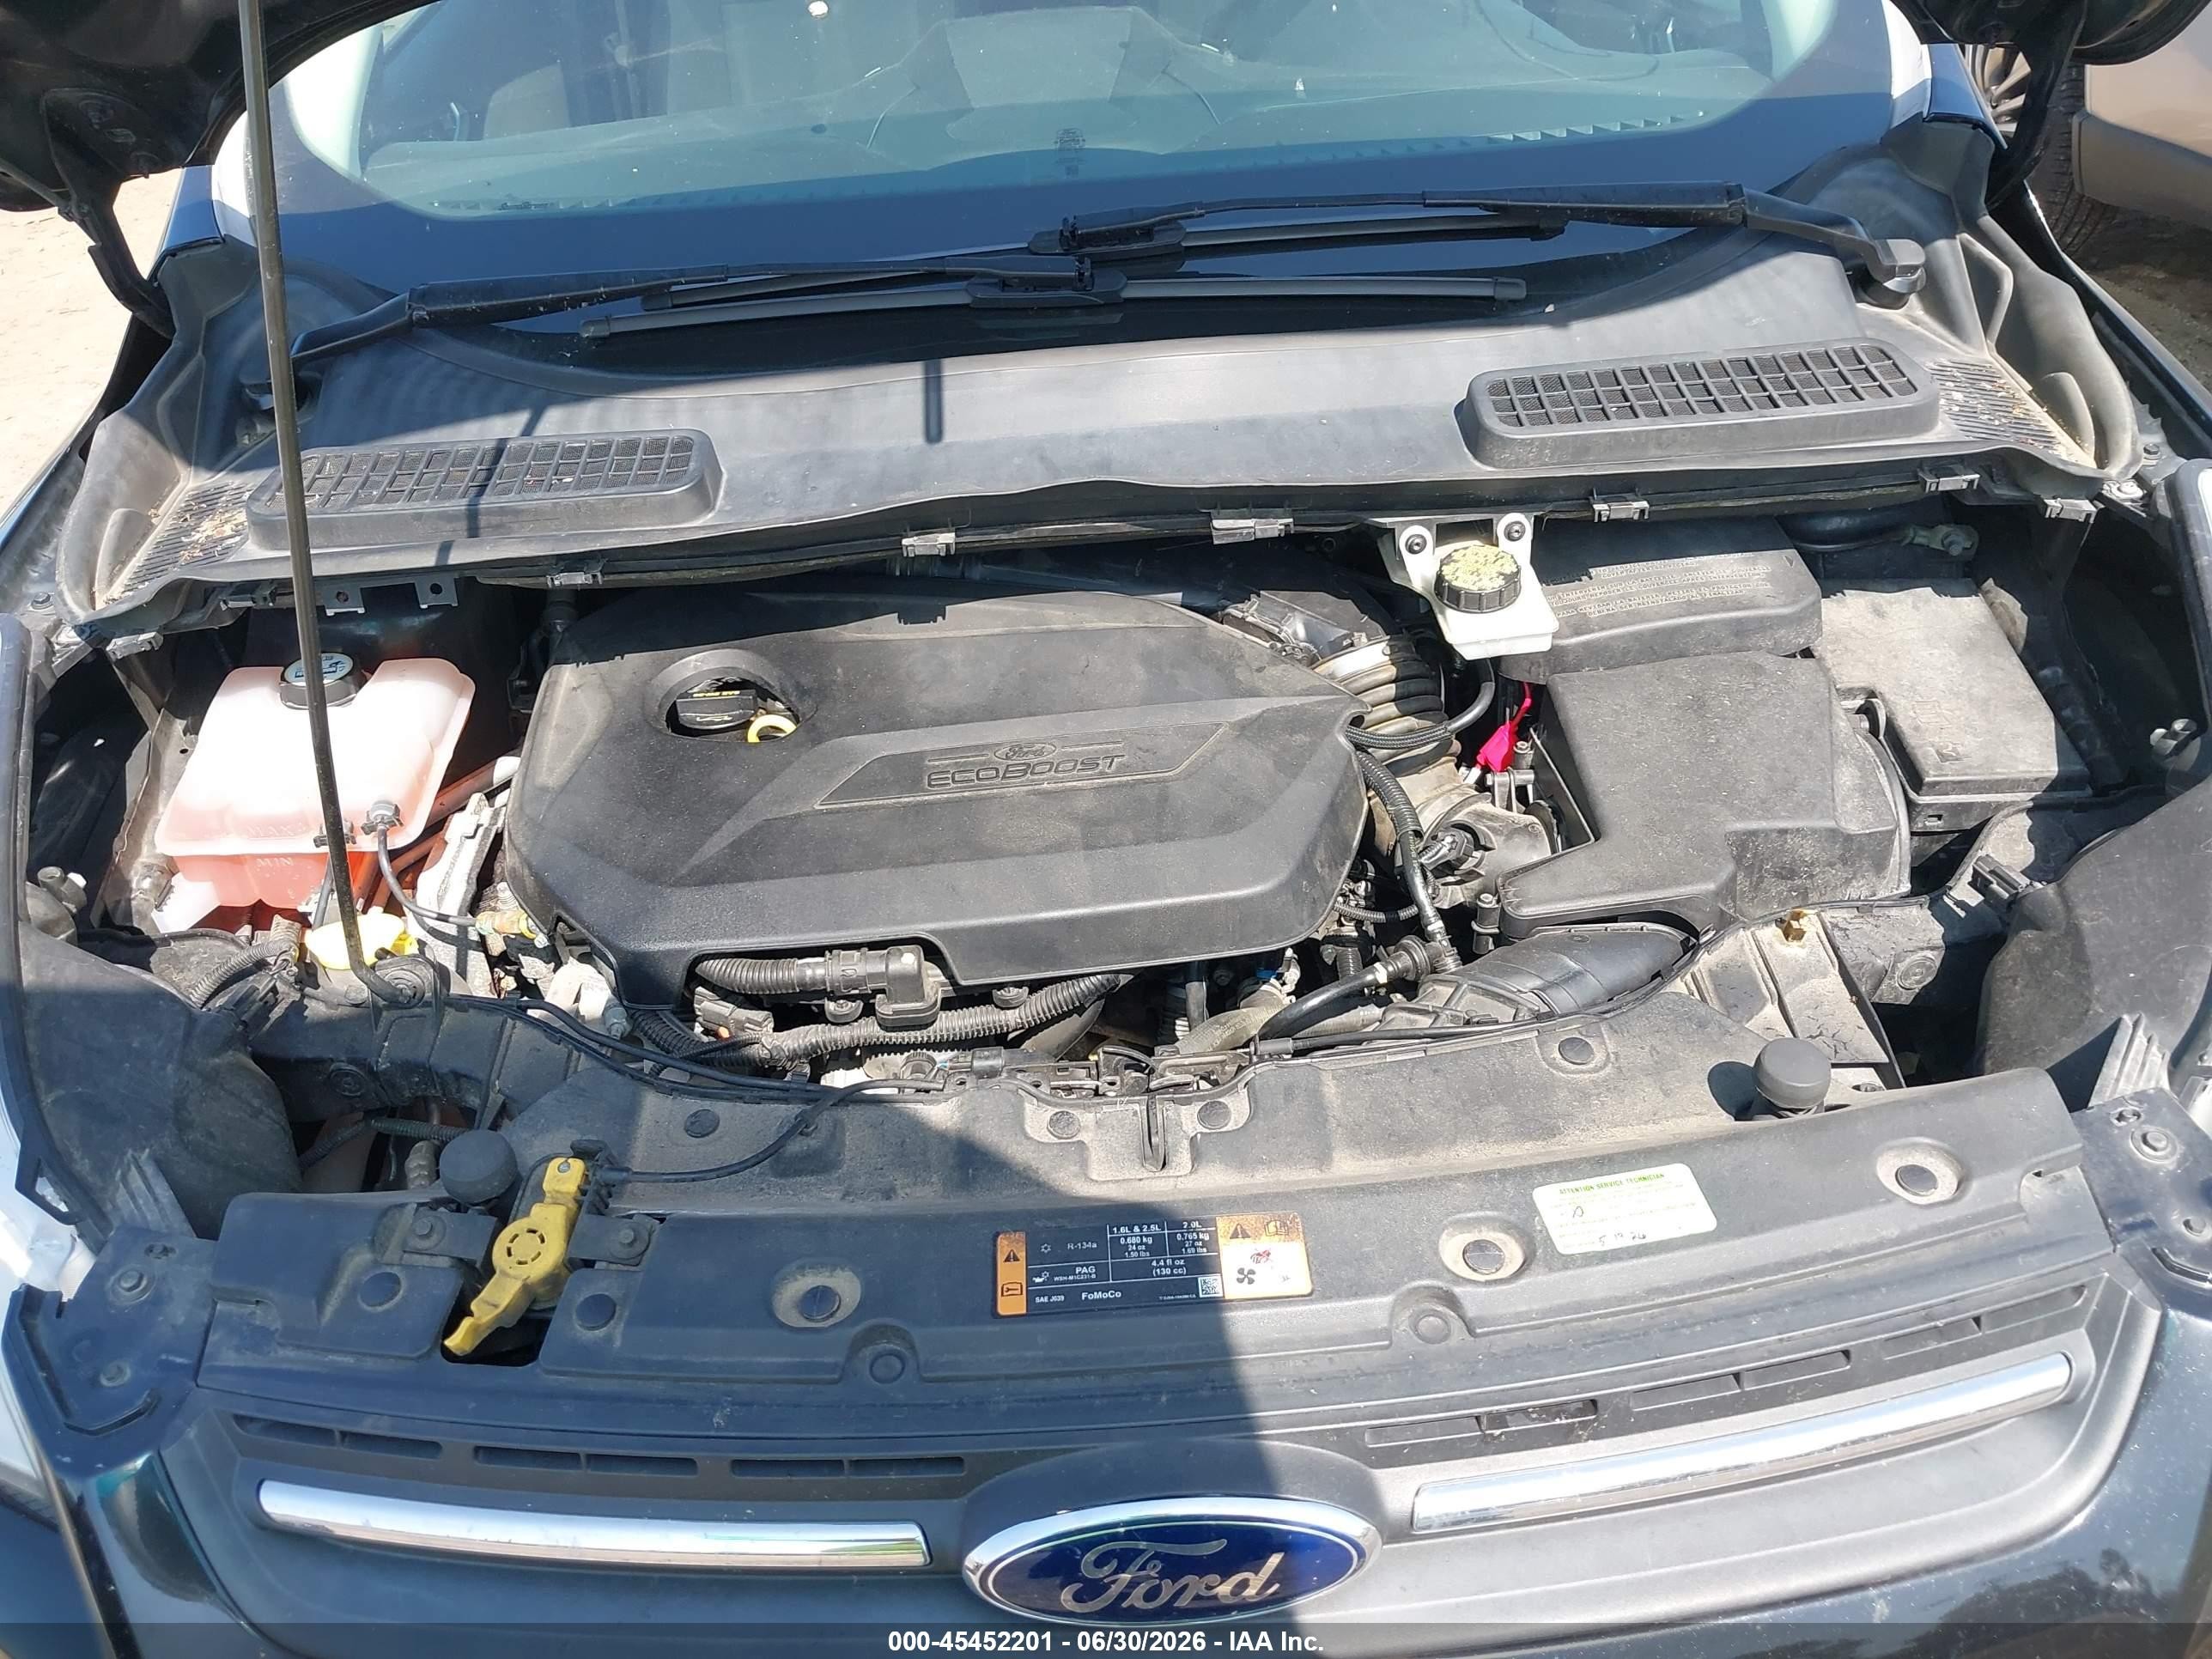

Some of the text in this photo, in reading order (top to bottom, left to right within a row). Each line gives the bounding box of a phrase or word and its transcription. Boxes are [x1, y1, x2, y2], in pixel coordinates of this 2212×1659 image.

[1559, 1185, 1595, 1194] ATTENTION
[1596, 1180, 1624, 1190] SERVICE
[1626, 1173, 1665, 1183] TECHNICIAN
[1182, 1220, 1202, 1229] 2.0L
[1143, 1236, 1153, 1244] kg
[1176, 1232, 1210, 1241] 0.765 kg
[1067, 1241, 1097, 1250] R-134a
[1075, 1266, 1096, 1274] PAG
[1152, 1267, 1187, 1277] (130 cc)
[1081, 1291, 1121, 1300] FoMoCo
[1060, 1538, 1285, 1613] Ford
